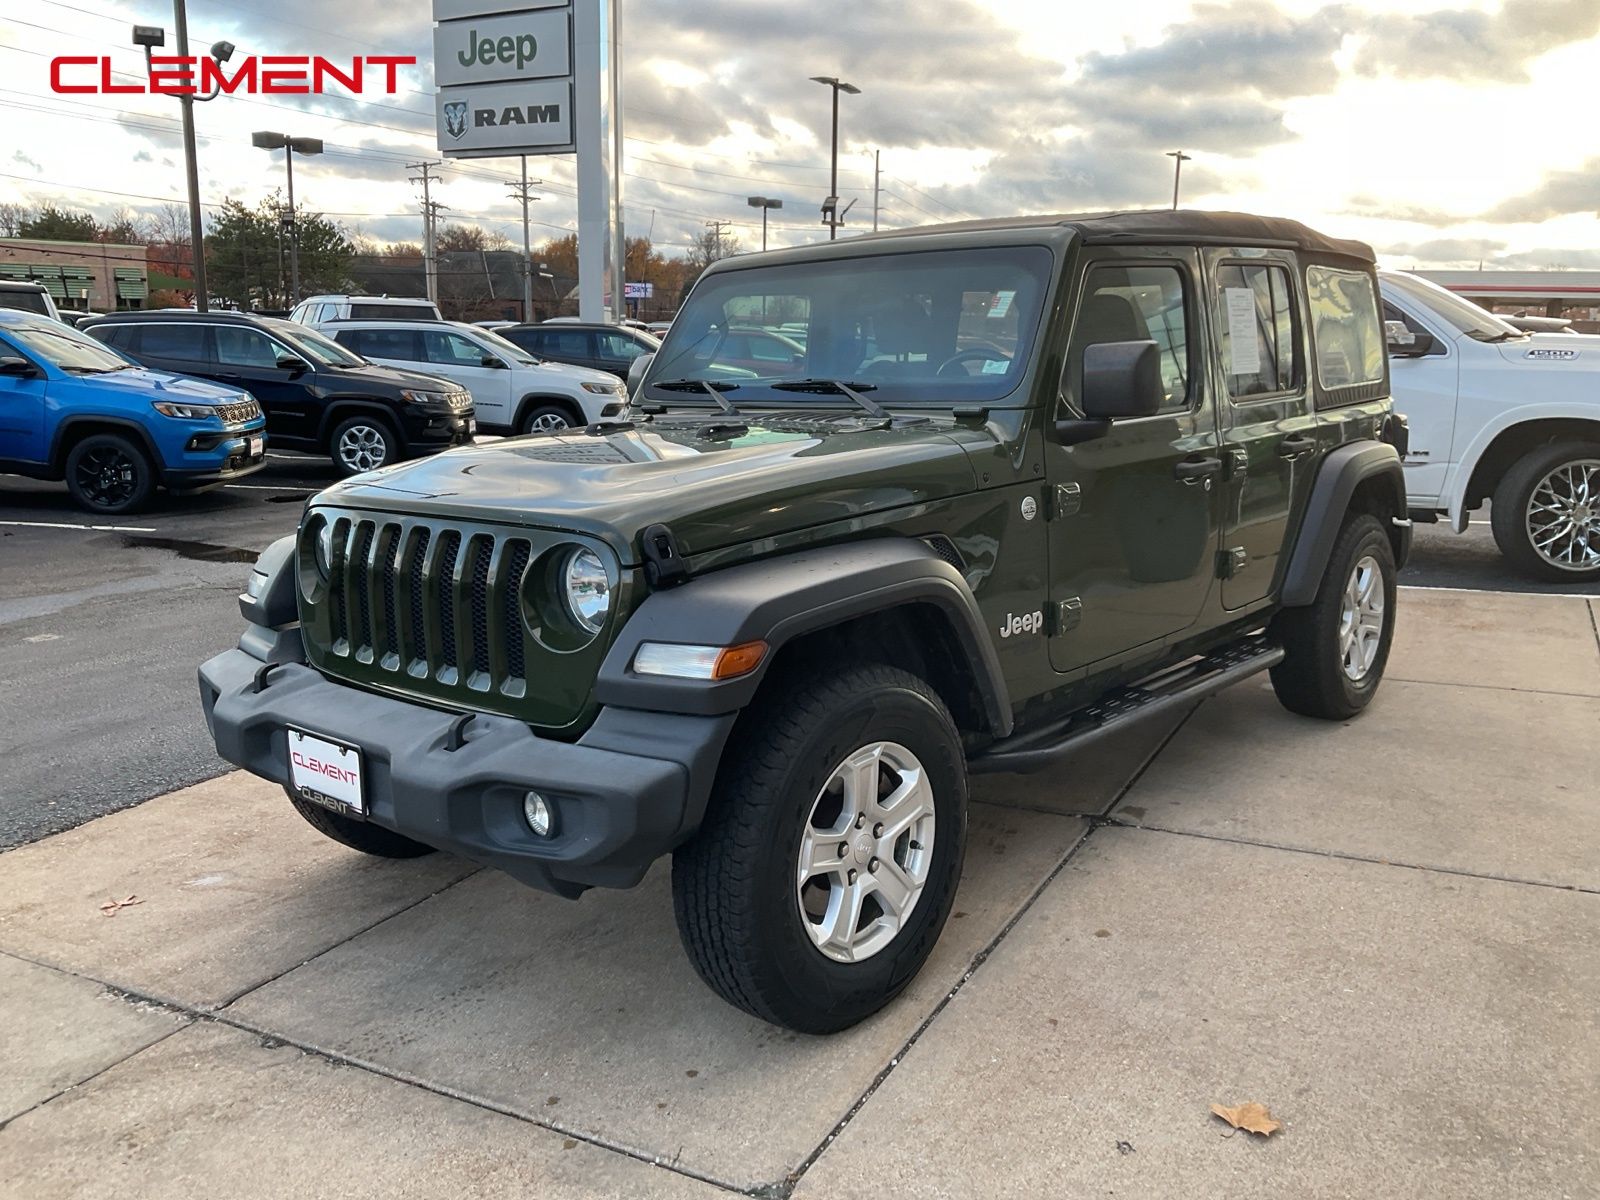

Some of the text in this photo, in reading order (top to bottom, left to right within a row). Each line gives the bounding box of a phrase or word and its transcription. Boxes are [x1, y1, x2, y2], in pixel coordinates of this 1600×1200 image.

[457, 29, 538, 70] Jeep
[474, 104, 560, 127] RAM
[1000, 610, 1043, 638] Jeep
[292, 751, 357, 785] CLEMENT
[302, 787, 348, 814] CLEMENT
